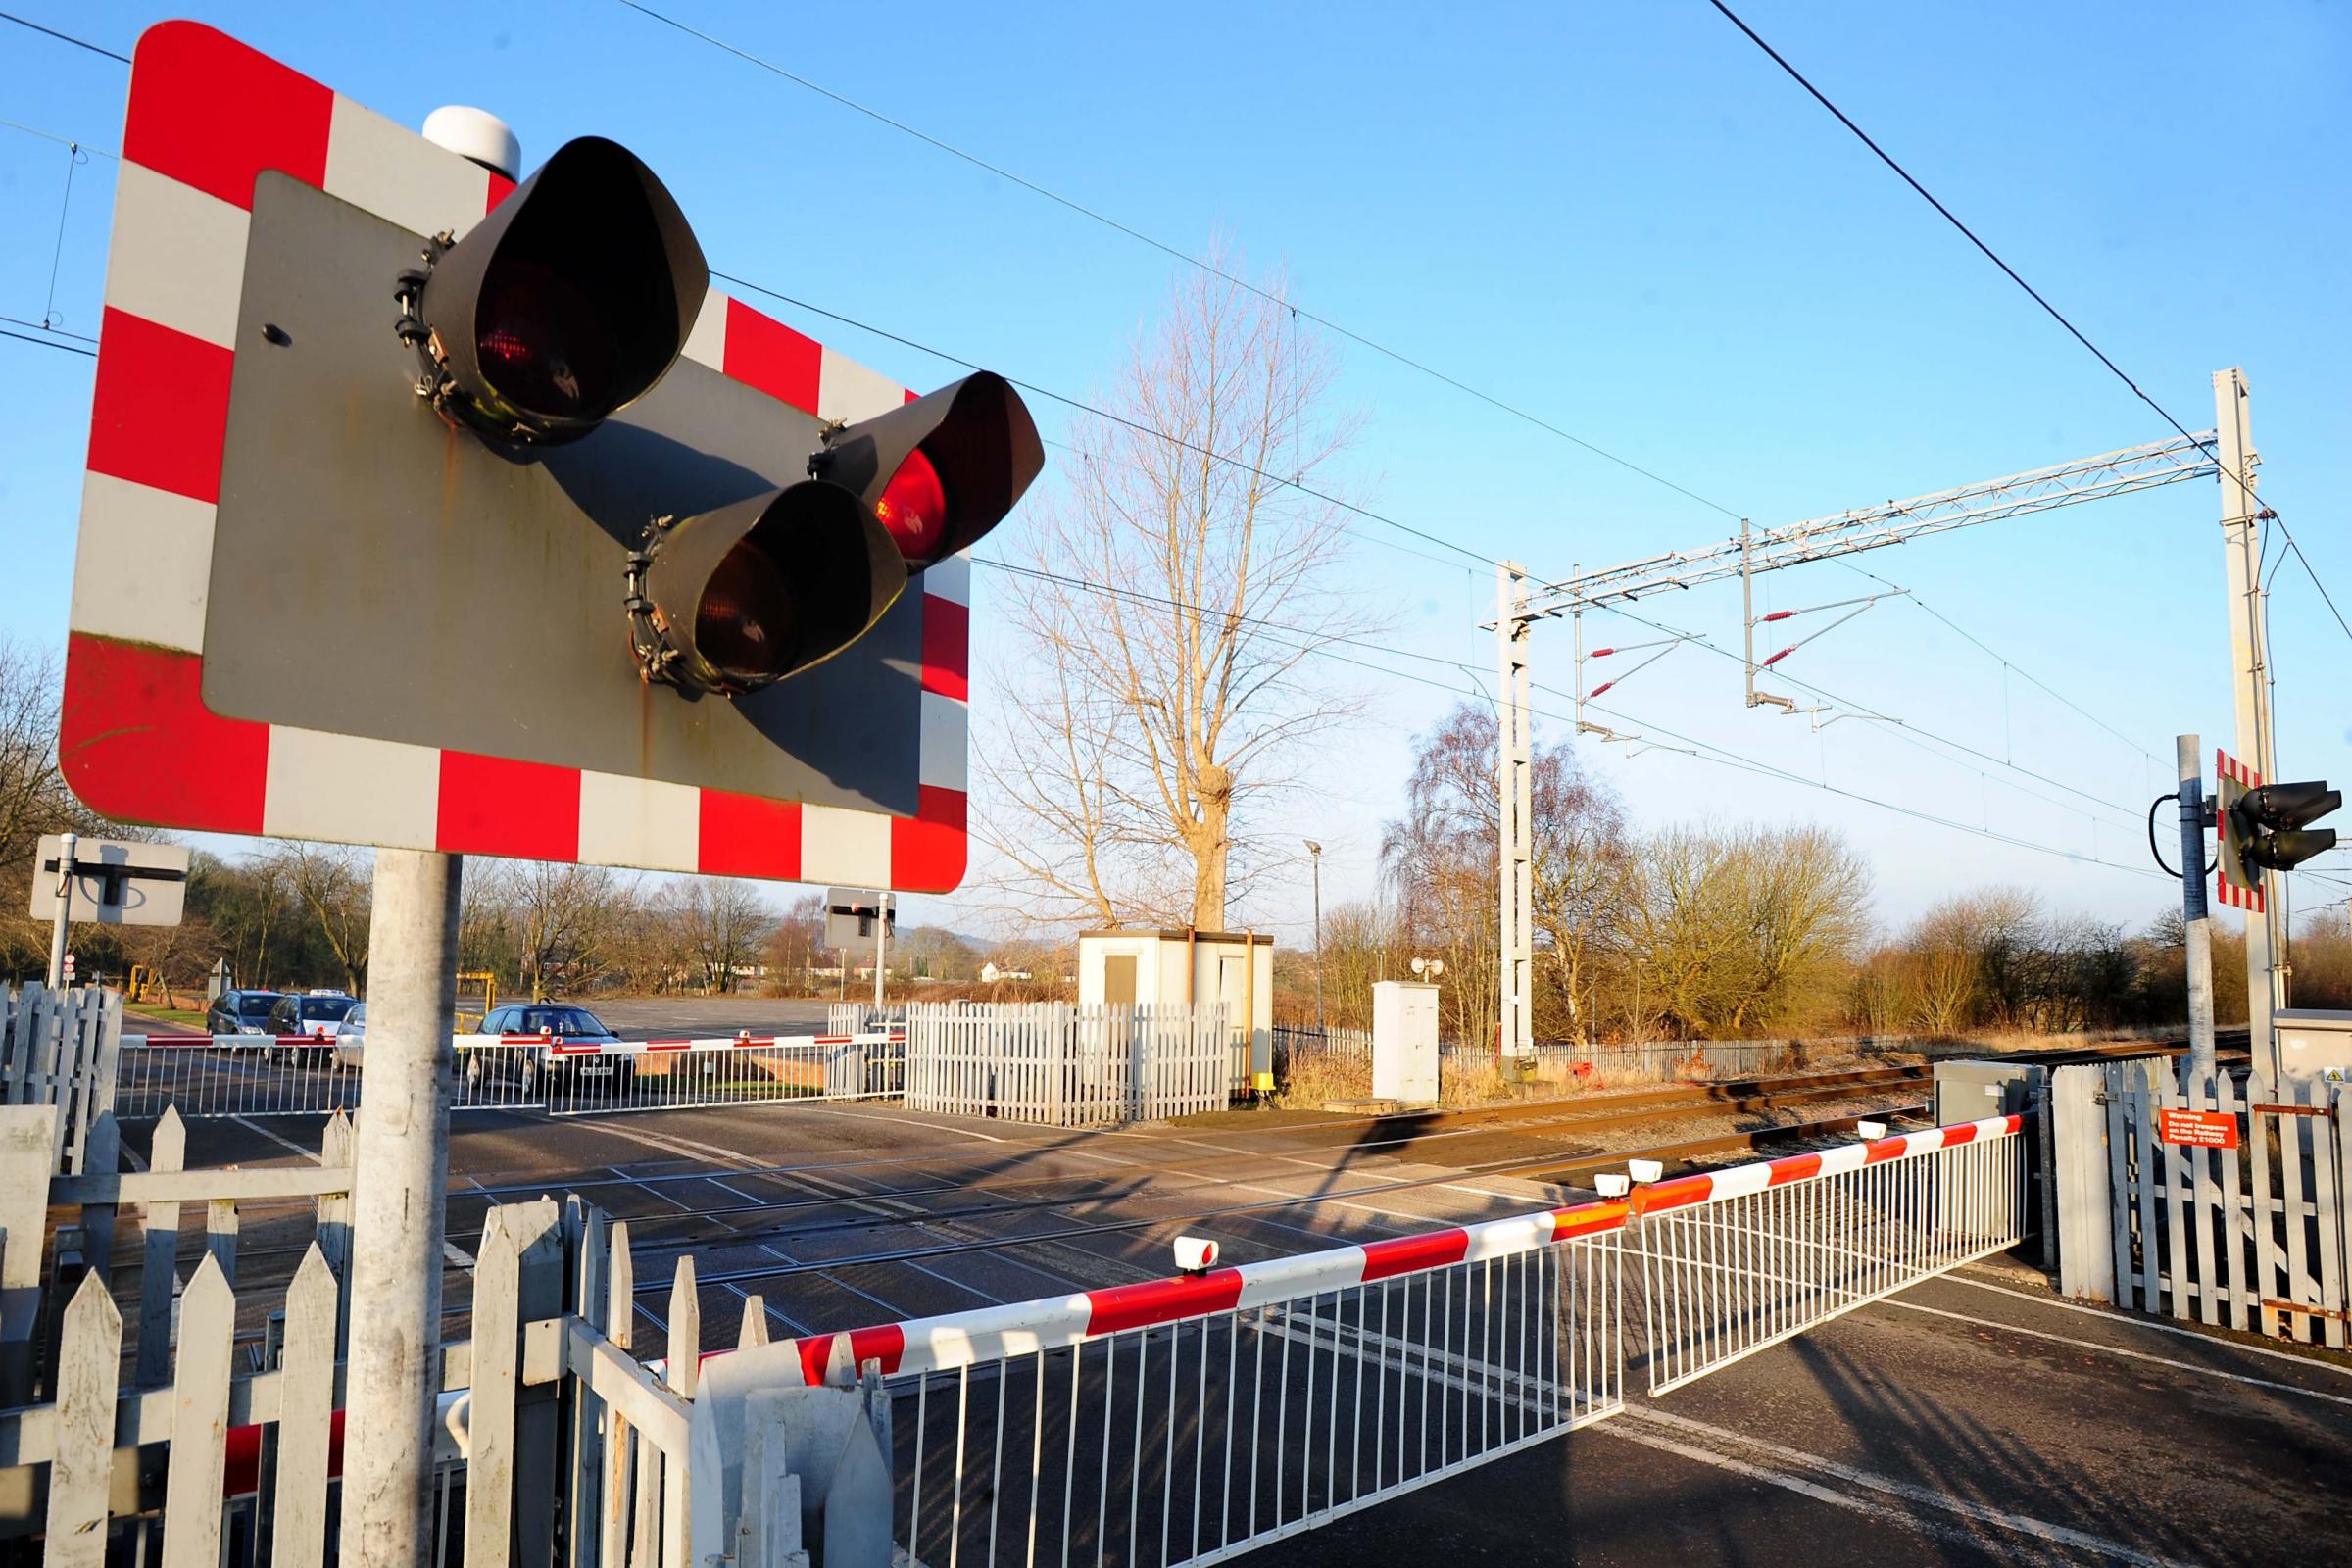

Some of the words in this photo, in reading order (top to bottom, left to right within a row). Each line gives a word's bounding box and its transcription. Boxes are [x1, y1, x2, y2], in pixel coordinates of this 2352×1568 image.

[2168, 1112, 2202, 1122] Warning
[2194, 1129, 2224, 1138] Railway
[2169, 1133, 2197, 1142] Penalty
[2199, 1136, 2225, 1145] £1000
